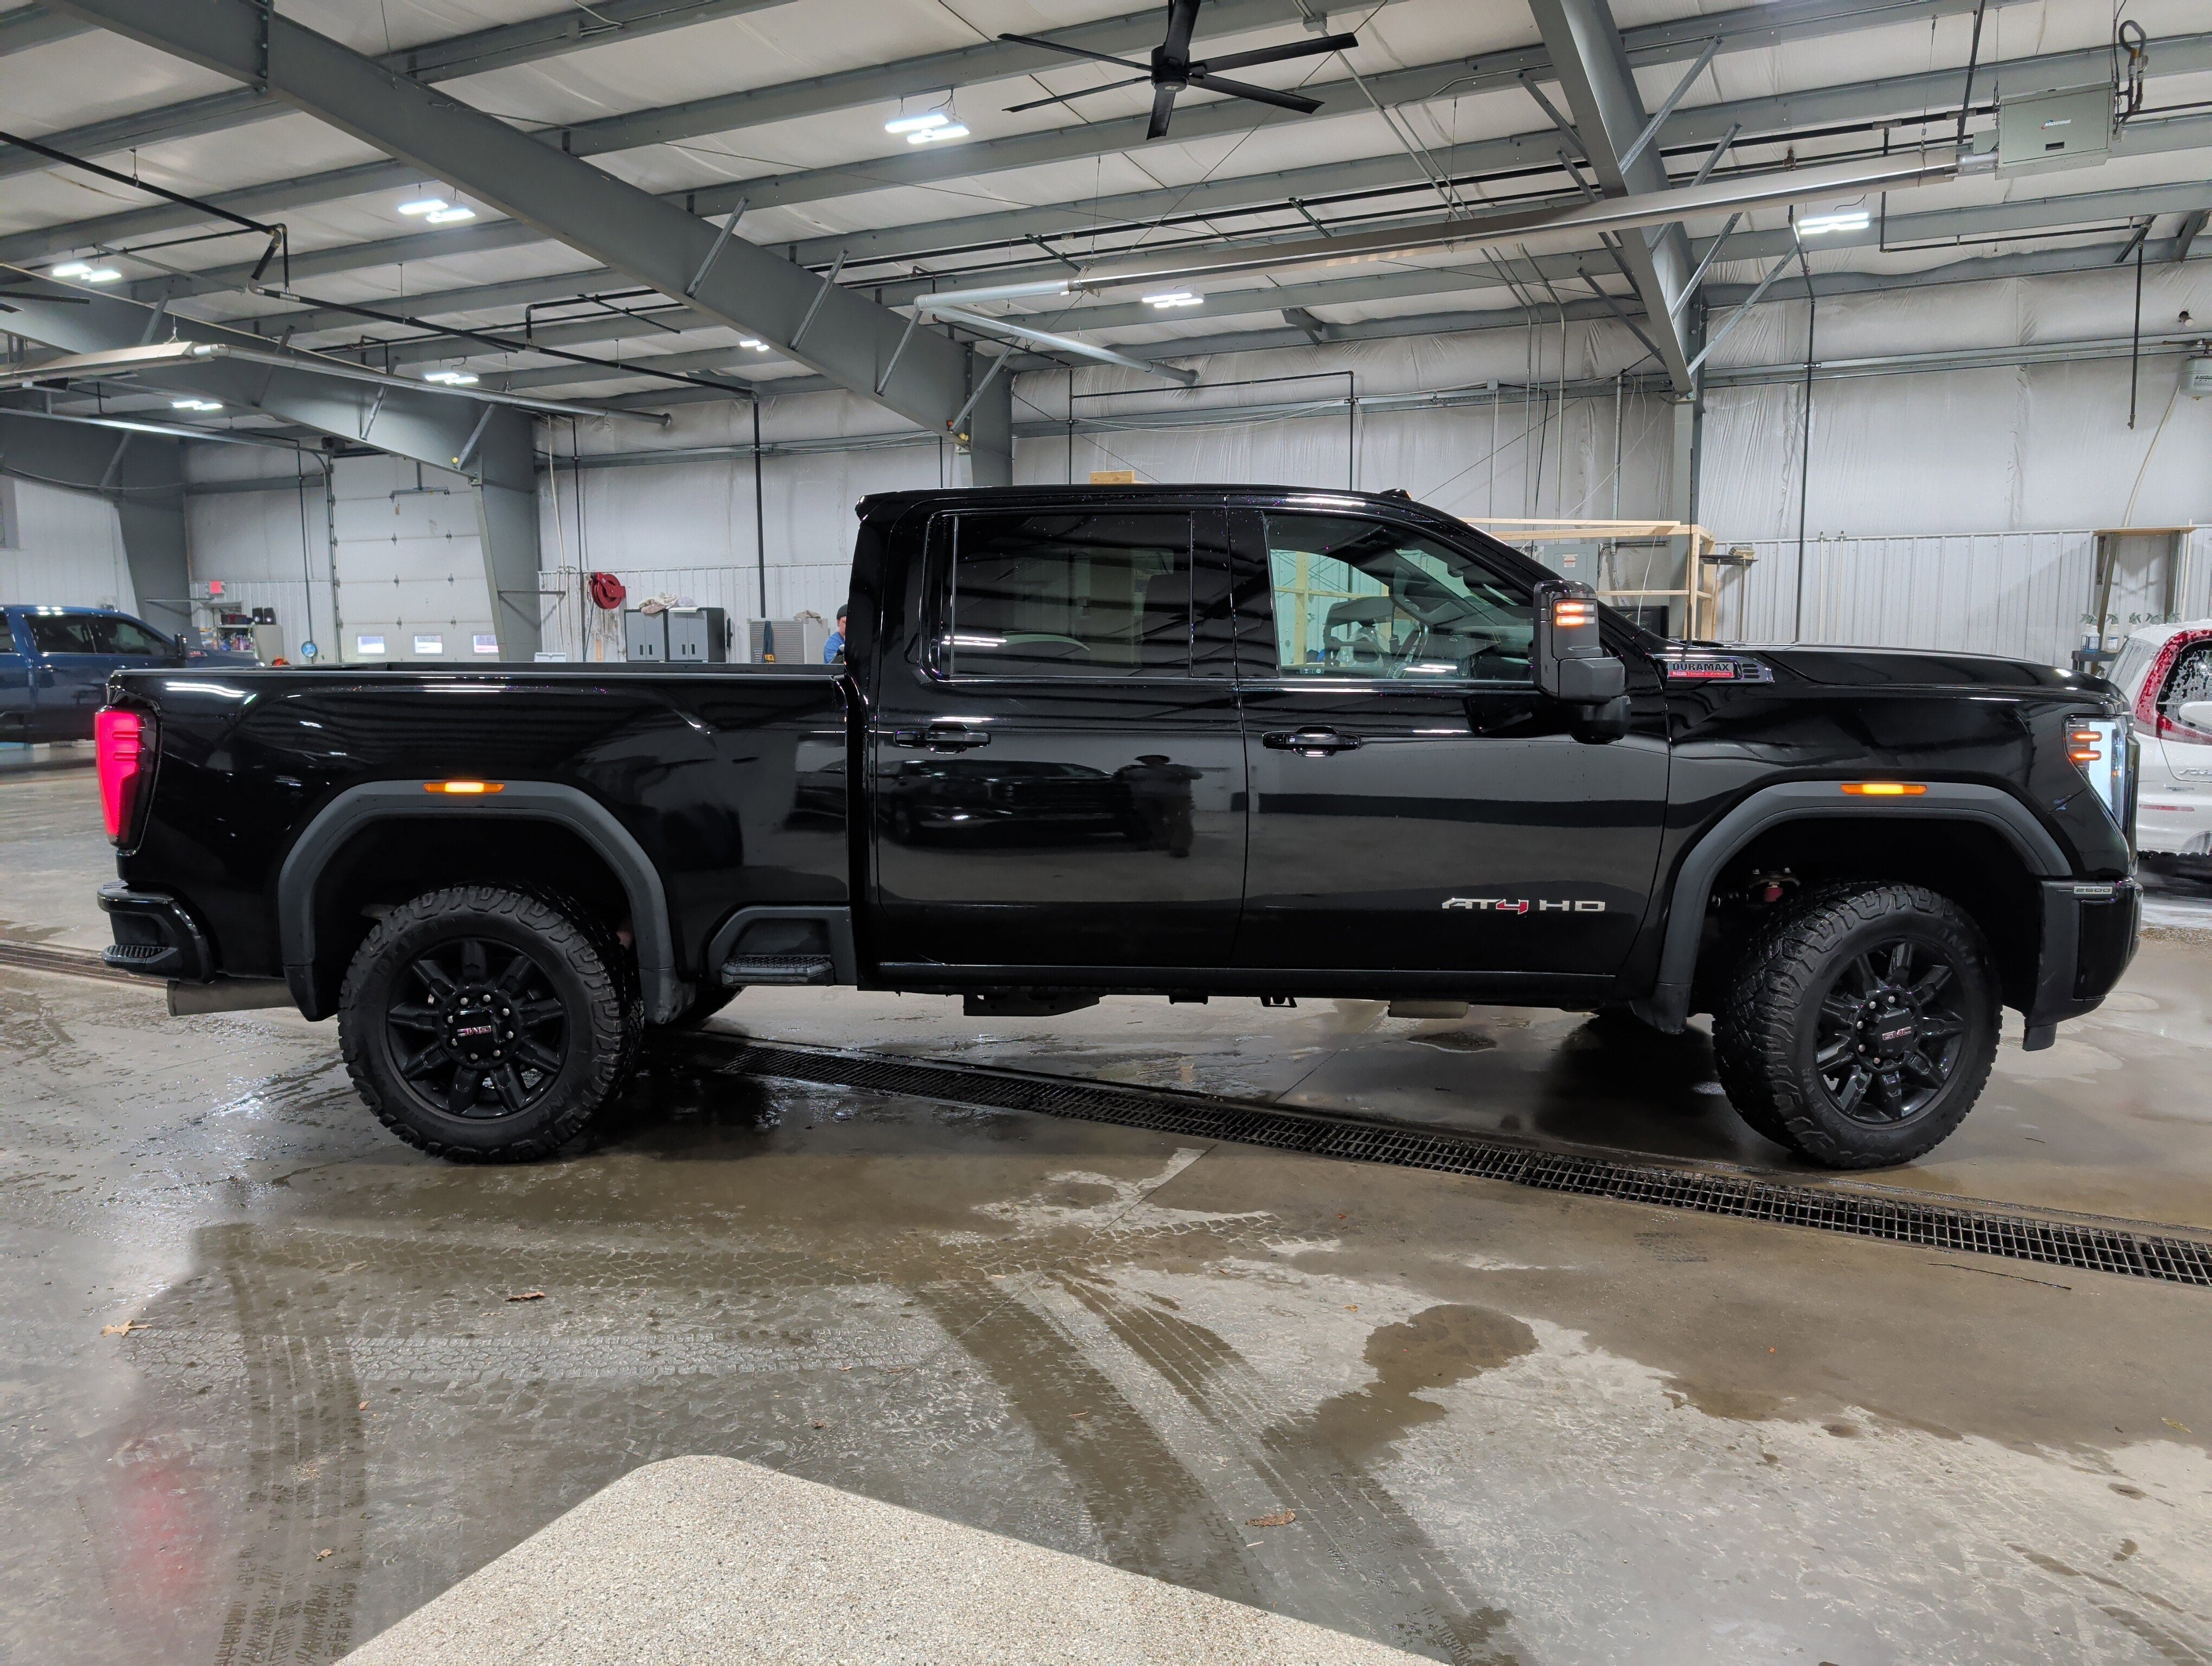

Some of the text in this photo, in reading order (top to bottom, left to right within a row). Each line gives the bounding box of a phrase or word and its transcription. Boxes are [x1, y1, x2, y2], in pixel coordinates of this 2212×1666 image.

[1672, 663, 1729, 671] DURAMAX
[1442, 898, 1606, 915] AT4 HD
[457, 1025, 491, 1037] GMC
[1882, 1026, 1912, 1041] GMC
